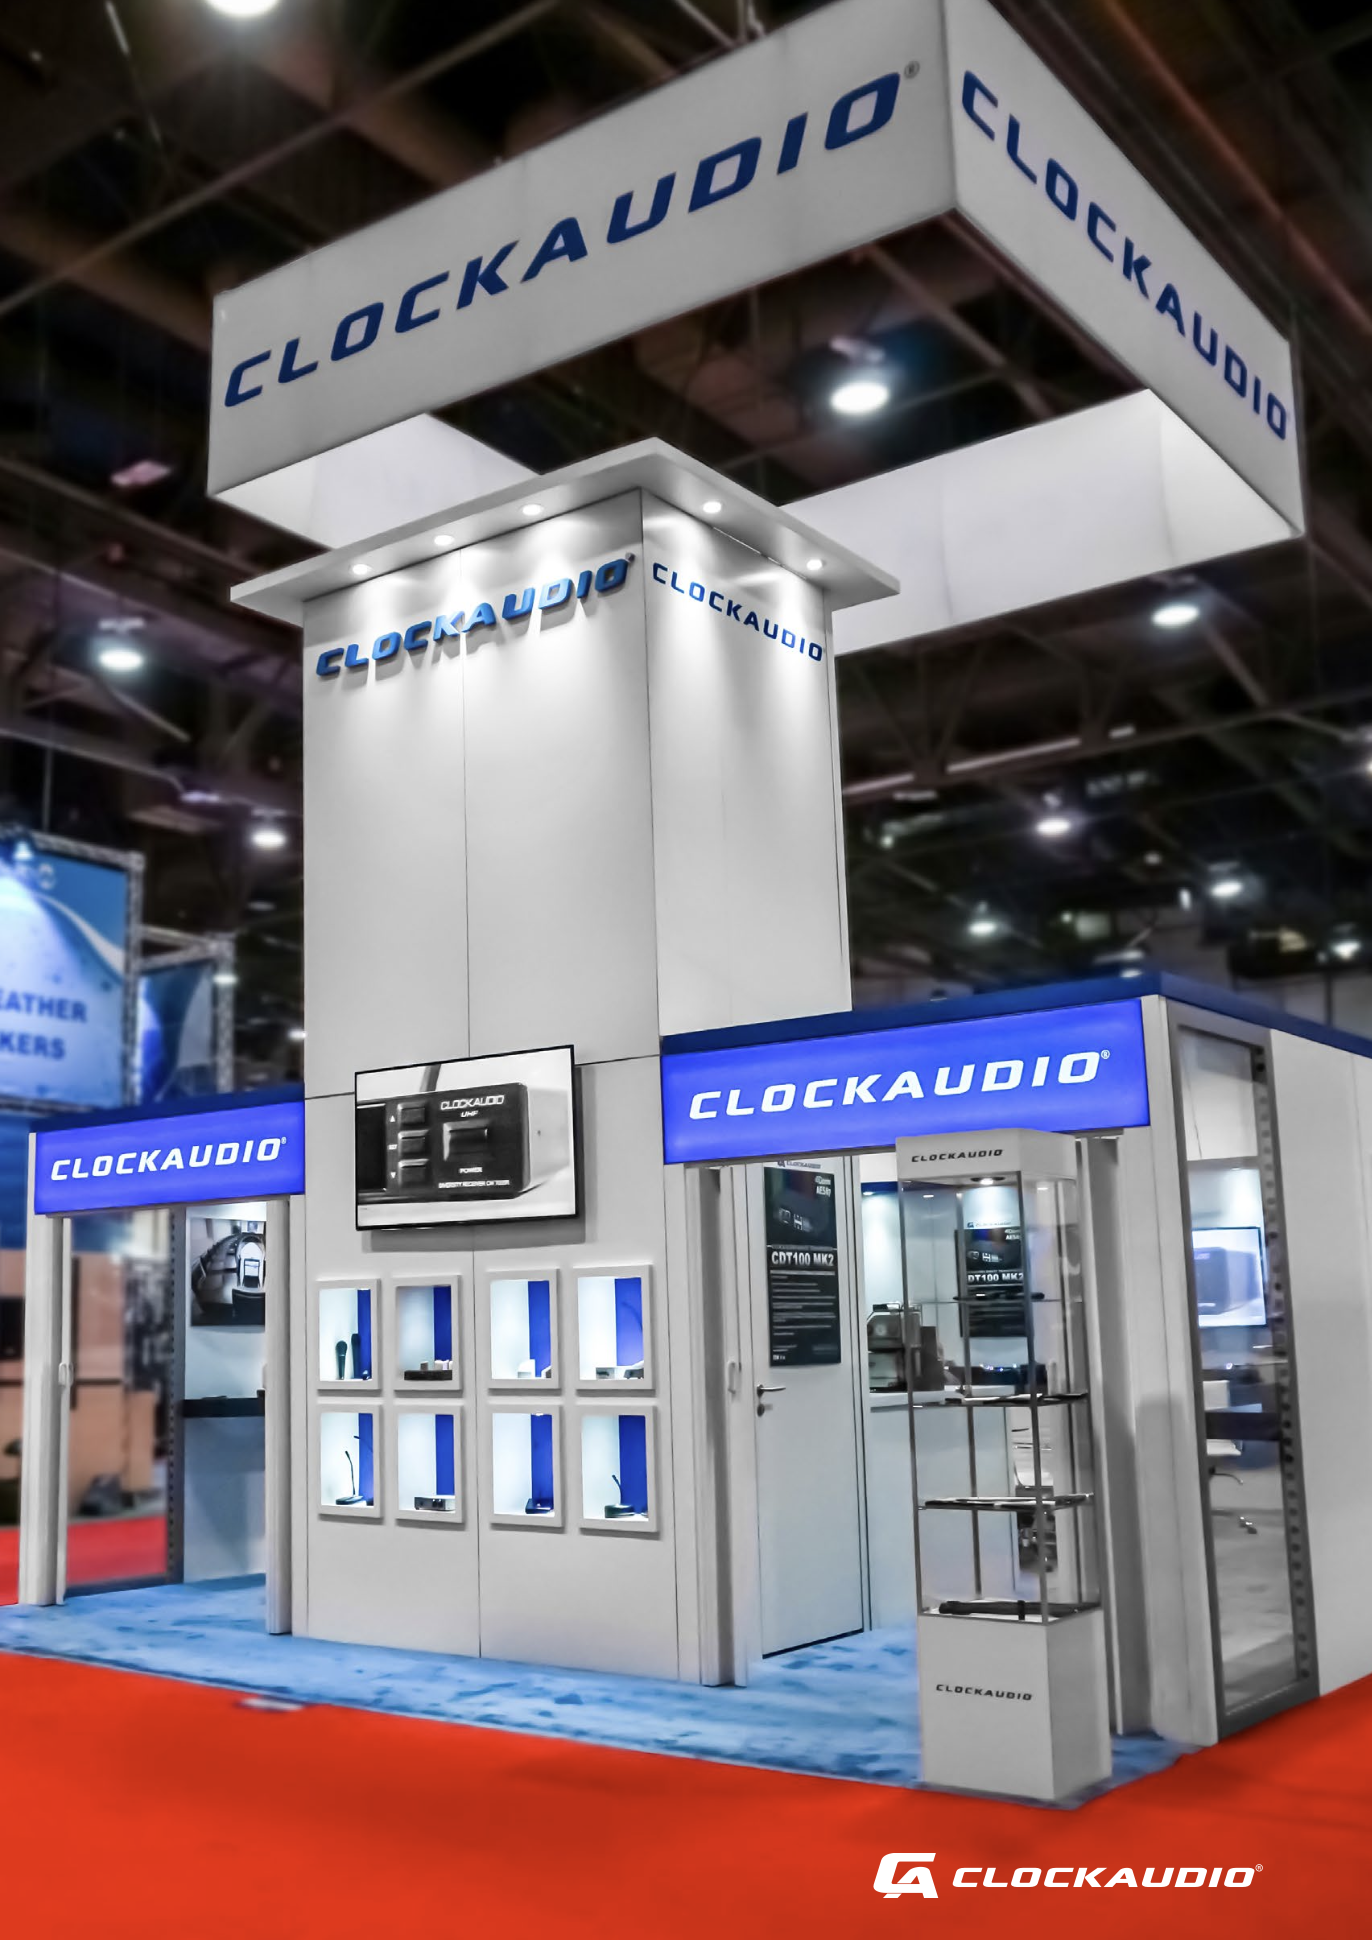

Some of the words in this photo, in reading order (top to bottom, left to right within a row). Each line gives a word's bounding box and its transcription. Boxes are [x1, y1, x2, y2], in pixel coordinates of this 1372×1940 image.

[962, 70, 1287, 440] CLOCKAUDIO
[652, 562, 823, 662] CLOCKAUDIO
[0, 988, 87, 1024] ATHER
[911, 1149, 1003, 1163] CLOCKAUDIO
[771, 1251, 811, 1266] CDT100
[813, 1253, 834, 1266] MK2
[967, 1274, 1000, 1282] DT100
[935, 1683, 1033, 1701] CLOCKAUDIO
